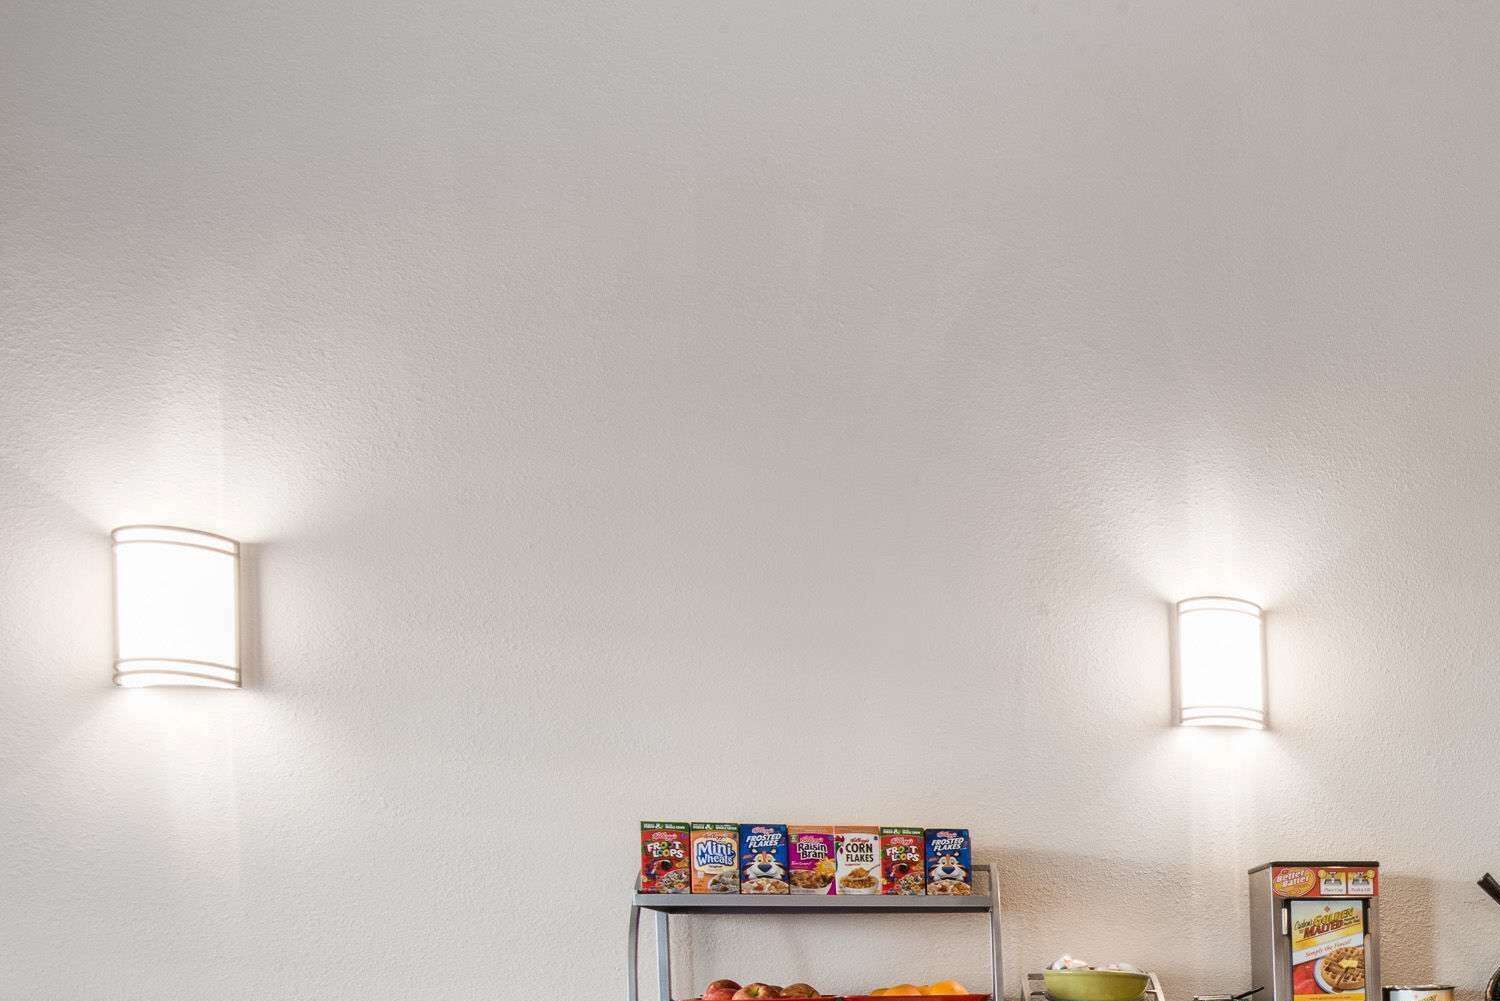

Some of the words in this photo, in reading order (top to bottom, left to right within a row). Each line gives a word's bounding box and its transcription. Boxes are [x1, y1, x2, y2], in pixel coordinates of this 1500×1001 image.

[746, 833, 782, 843] FROSTED
[931, 837, 964, 847] FROSTED
[748, 840, 778, 848] FLAKES
[797, 842, 827, 852] Raisin
[845, 842, 873, 853] CORN
[934, 843, 961, 852] FLAKES
[653, 848, 684, 858] LOOPS
[801, 850, 825, 859] Bran
[846, 852, 874, 862] FLAKES
[891, 853, 920, 862] LOOPS
